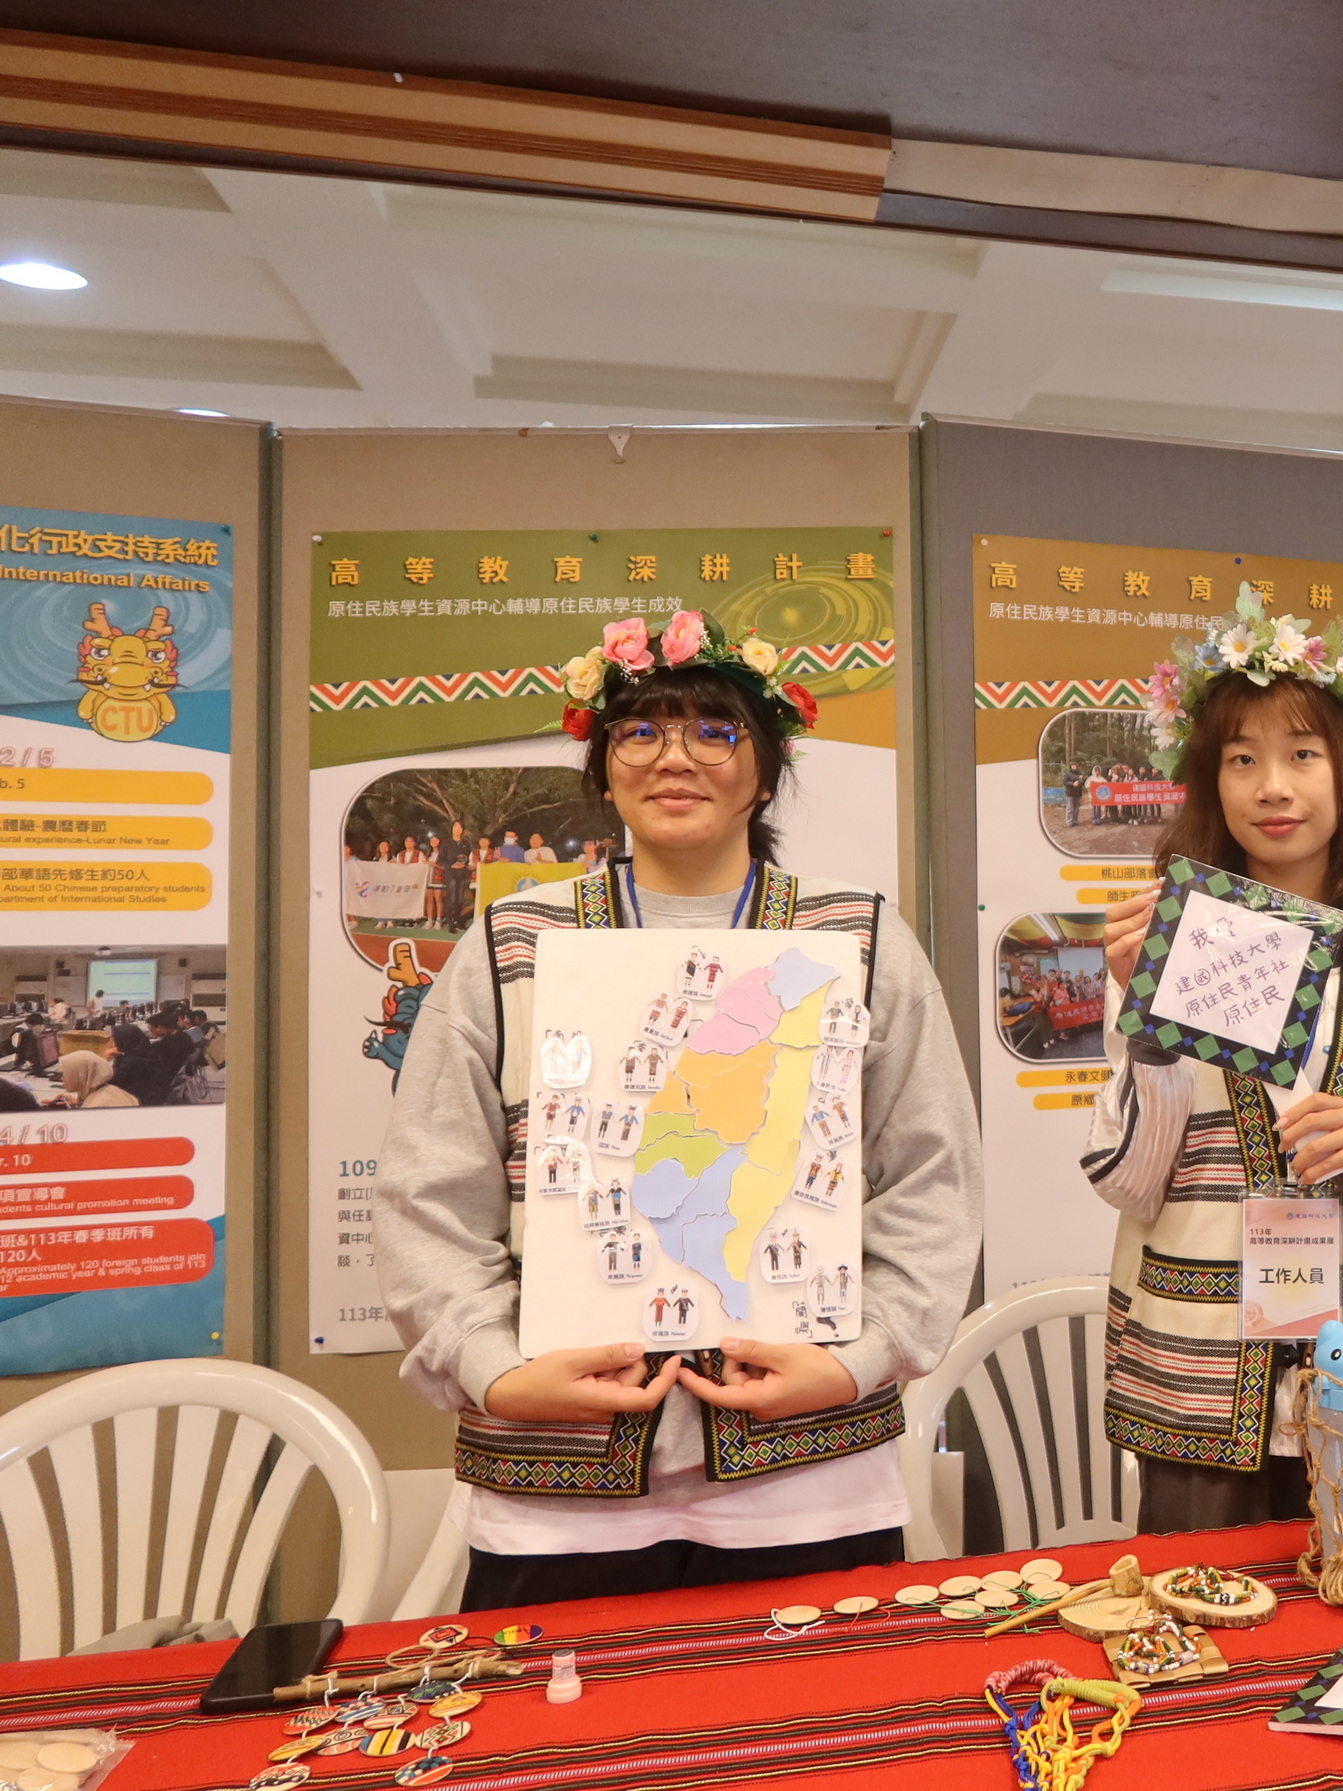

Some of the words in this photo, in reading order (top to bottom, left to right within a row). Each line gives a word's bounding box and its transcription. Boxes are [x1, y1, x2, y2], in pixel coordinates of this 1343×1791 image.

[330, 552, 876, 585] 高等教育深耕計畫
[140, 574, 210, 593] Affairs
[327, 595, 684, 618] 原住民族學生資源中心輔導原住民族學生成效
[101, 705, 154, 735] CTU
[17, 778, 25, 790] 5
[0, 819, 107, 833] 體驗-農曆春節
[119, 837, 143, 845] New
[146, 837, 170, 846] Year
[4, 884, 35, 892] About
[38, 884, 51, 892] 50
[55, 884, 98, 893] Chinese
[101, 885, 160, 894] preparatory
[163, 884, 206, 893] students
[48, 895, 58, 903] of
[61, 895, 125, 903] International
[128, 895, 167, 903] Studies
[1174, 931, 1283, 996] 建國科技大學
[1184, 959, 1290, 1018] 原住民青年社
[1223, 984, 1285, 1027] 原住民
[13, 1154, 32, 1166] 10
[338, 1159, 377, 1177] 109
[35, 1201, 73, 1212] cultural
[77, 1199, 129, 1211] promotion
[133, 1196, 174, 1207] meeting
[1250, 1228, 1272, 1236] 113年
[1249, 1236, 1335, 1246] 高等教育深耕計畫成果展
[80, 1259, 99, 1269] 120
[102, 1257, 138, 1269] foreign
[141, 1254, 185, 1264] students
[187, 1253, 206, 1263] join
[16, 1271, 68, 1281] academic
[71, 1270, 95, 1280] year
[97, 1268, 105, 1277] &
[109, 1264, 141, 1276] spring
[144, 1263, 171, 1272] class
[173, 1262, 185, 1270] of
[188, 1260, 206, 1270] 113
[1258, 1267, 1325, 1285] 工作人員
[338, 1306, 390, 1322] 113年
